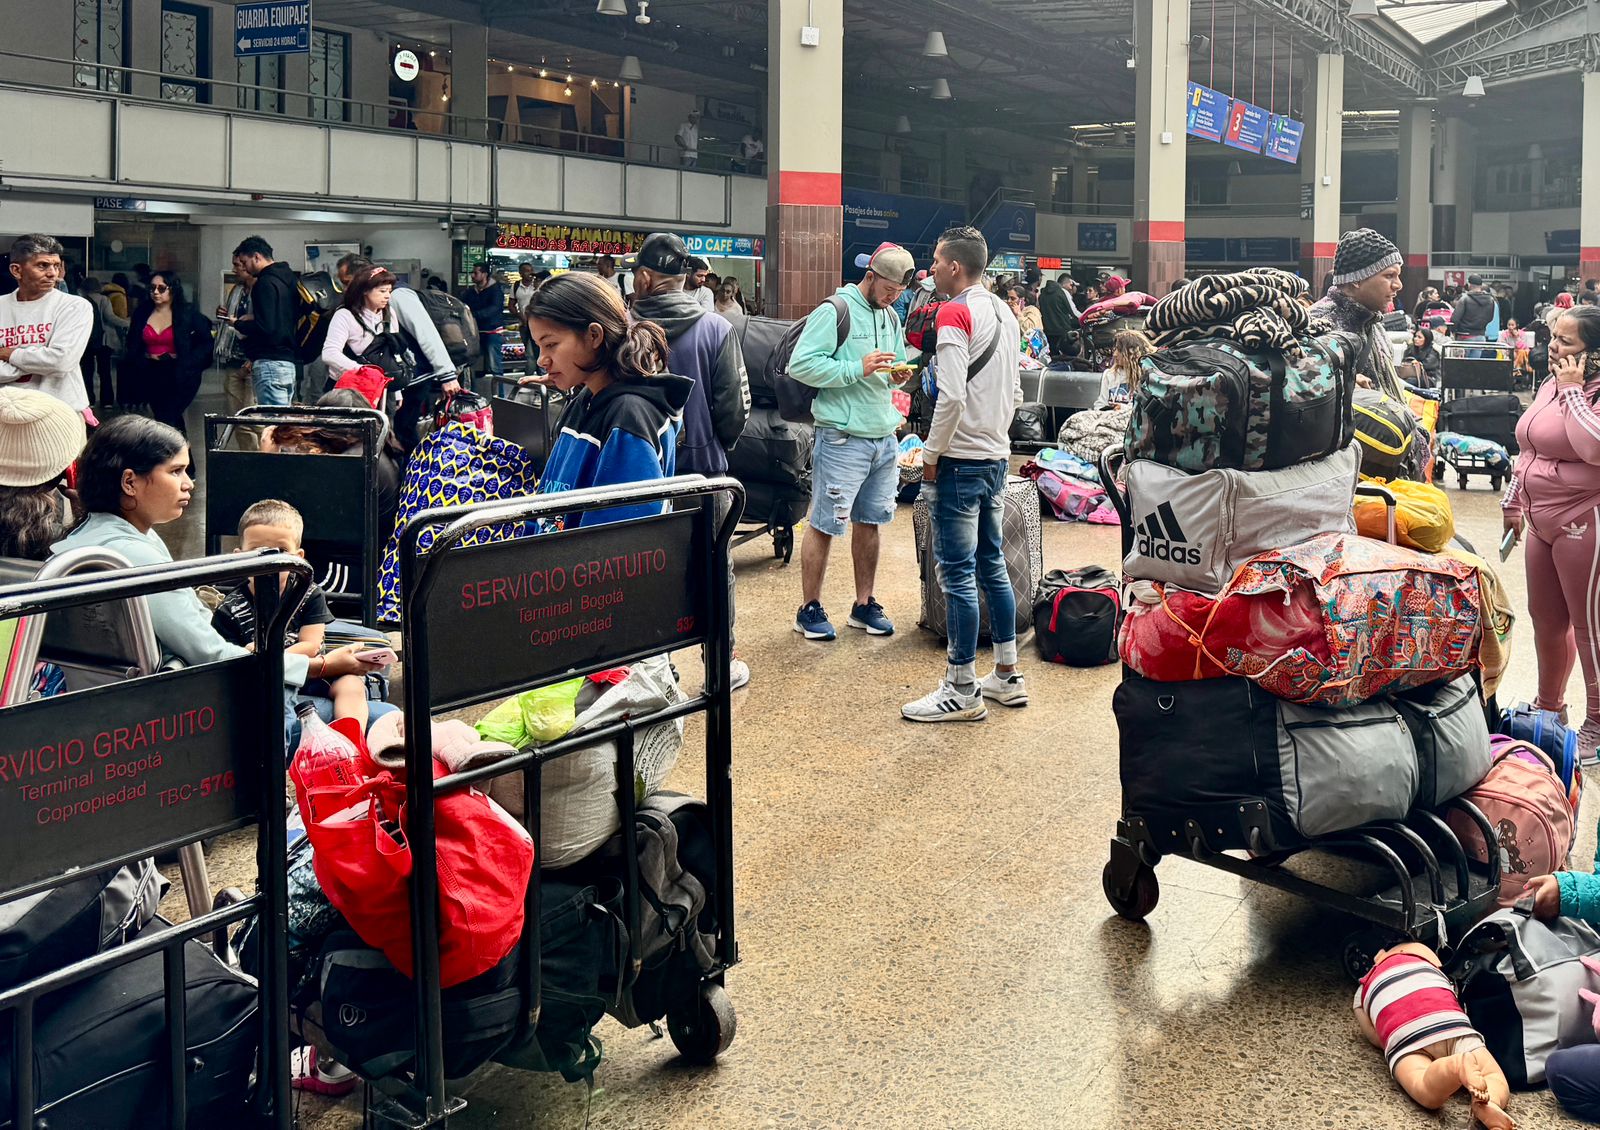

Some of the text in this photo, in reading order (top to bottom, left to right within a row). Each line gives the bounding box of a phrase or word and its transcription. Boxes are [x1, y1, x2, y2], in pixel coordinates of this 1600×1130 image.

[237, 4, 309, 29] GUARDA EQUIPAJE
[252, 36, 296, 48] SERVICIO 24 HORAS
[1232, 113, 1242, 132] 3
[96, 197, 123, 209] PASE
[845, 204, 866, 217] Pasajes
[866, 207, 873, 216] de
[873, 207, 882, 217] bus
[496, 235, 567, 251] COMIDAS
[705, 238, 733, 252] CAFÉ
[5, 334, 46, 347] BULLS
[461, 548, 666, 611] SERVICIO GRATUITO
[519, 587, 625, 624] Terminal Bogotá
[529, 612, 613, 646] Copropiedad
[93, 705, 216, 759] GRATUITO
[647, 724, 668, 753] AHORRO
[18, 751, 163, 802] Terminal Bogotá
[37, 780, 147, 825] Copropiedad
